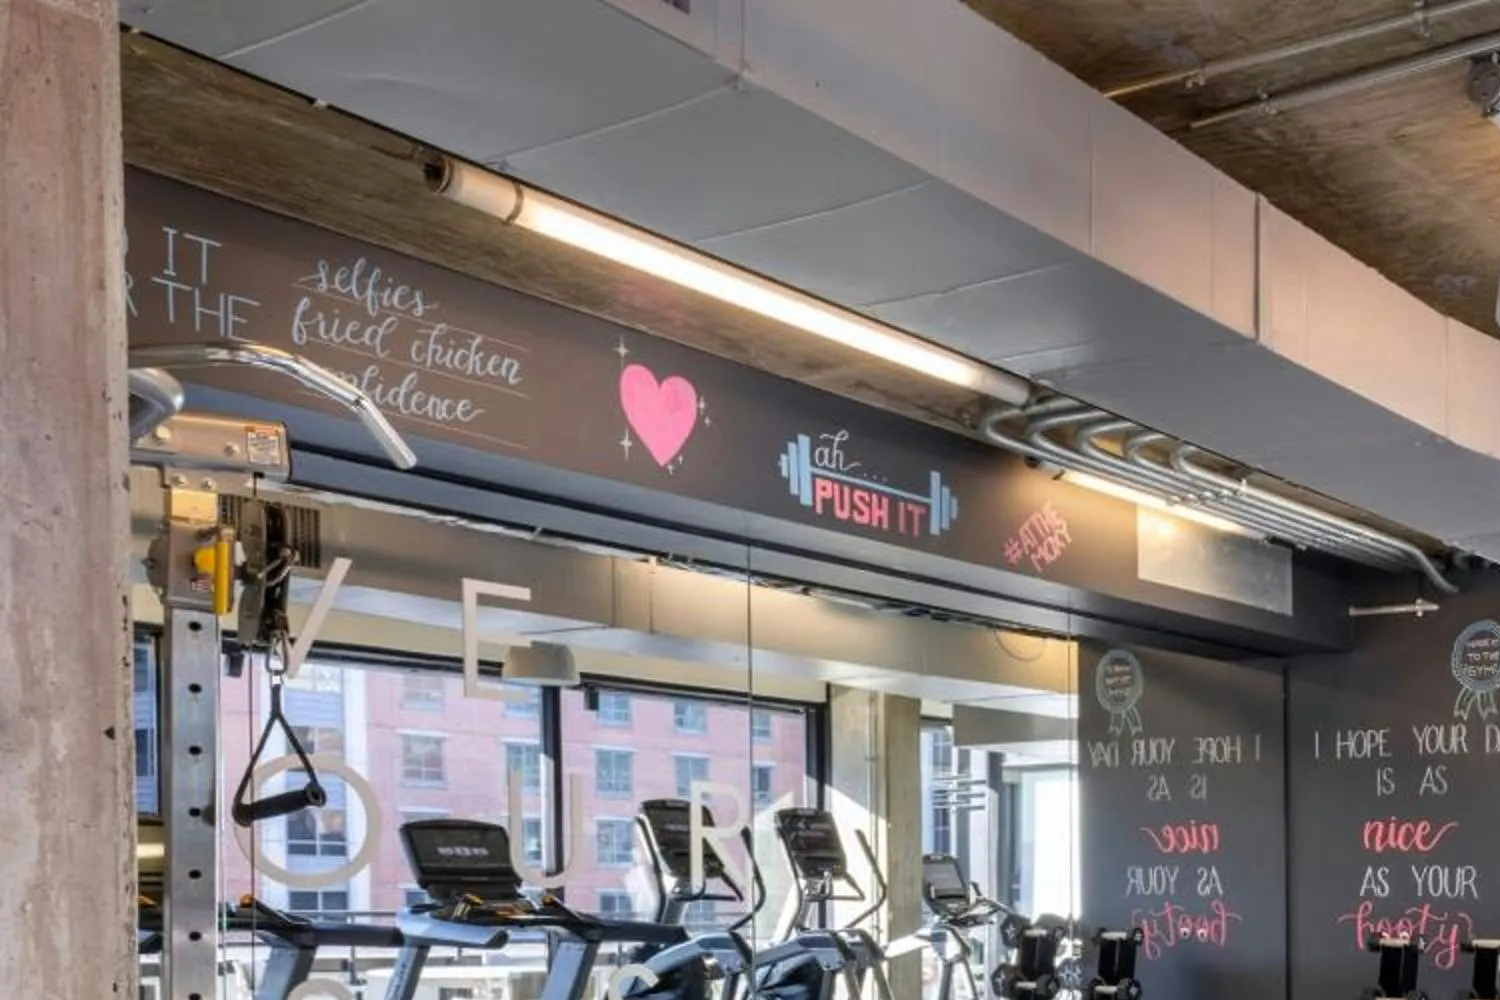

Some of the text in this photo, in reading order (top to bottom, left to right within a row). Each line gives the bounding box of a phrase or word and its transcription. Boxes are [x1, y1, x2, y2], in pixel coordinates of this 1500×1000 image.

[162, 226, 223, 285] IT
[151, 276, 261, 344] THE
[297, 257, 438, 316] selfies
[292, 297, 523, 385] fried chicken
[815, 478, 928, 536] PUSH IT
[1315, 730, 1320, 759] I
[1336, 729, 1392, 760] HOPE
[1412, 723, 1469, 755] YOUR
[1376, 765, 1449, 797] IS AS
[1363, 816, 1461, 854] nice
[1359, 865, 1479, 899] AS YOUR
